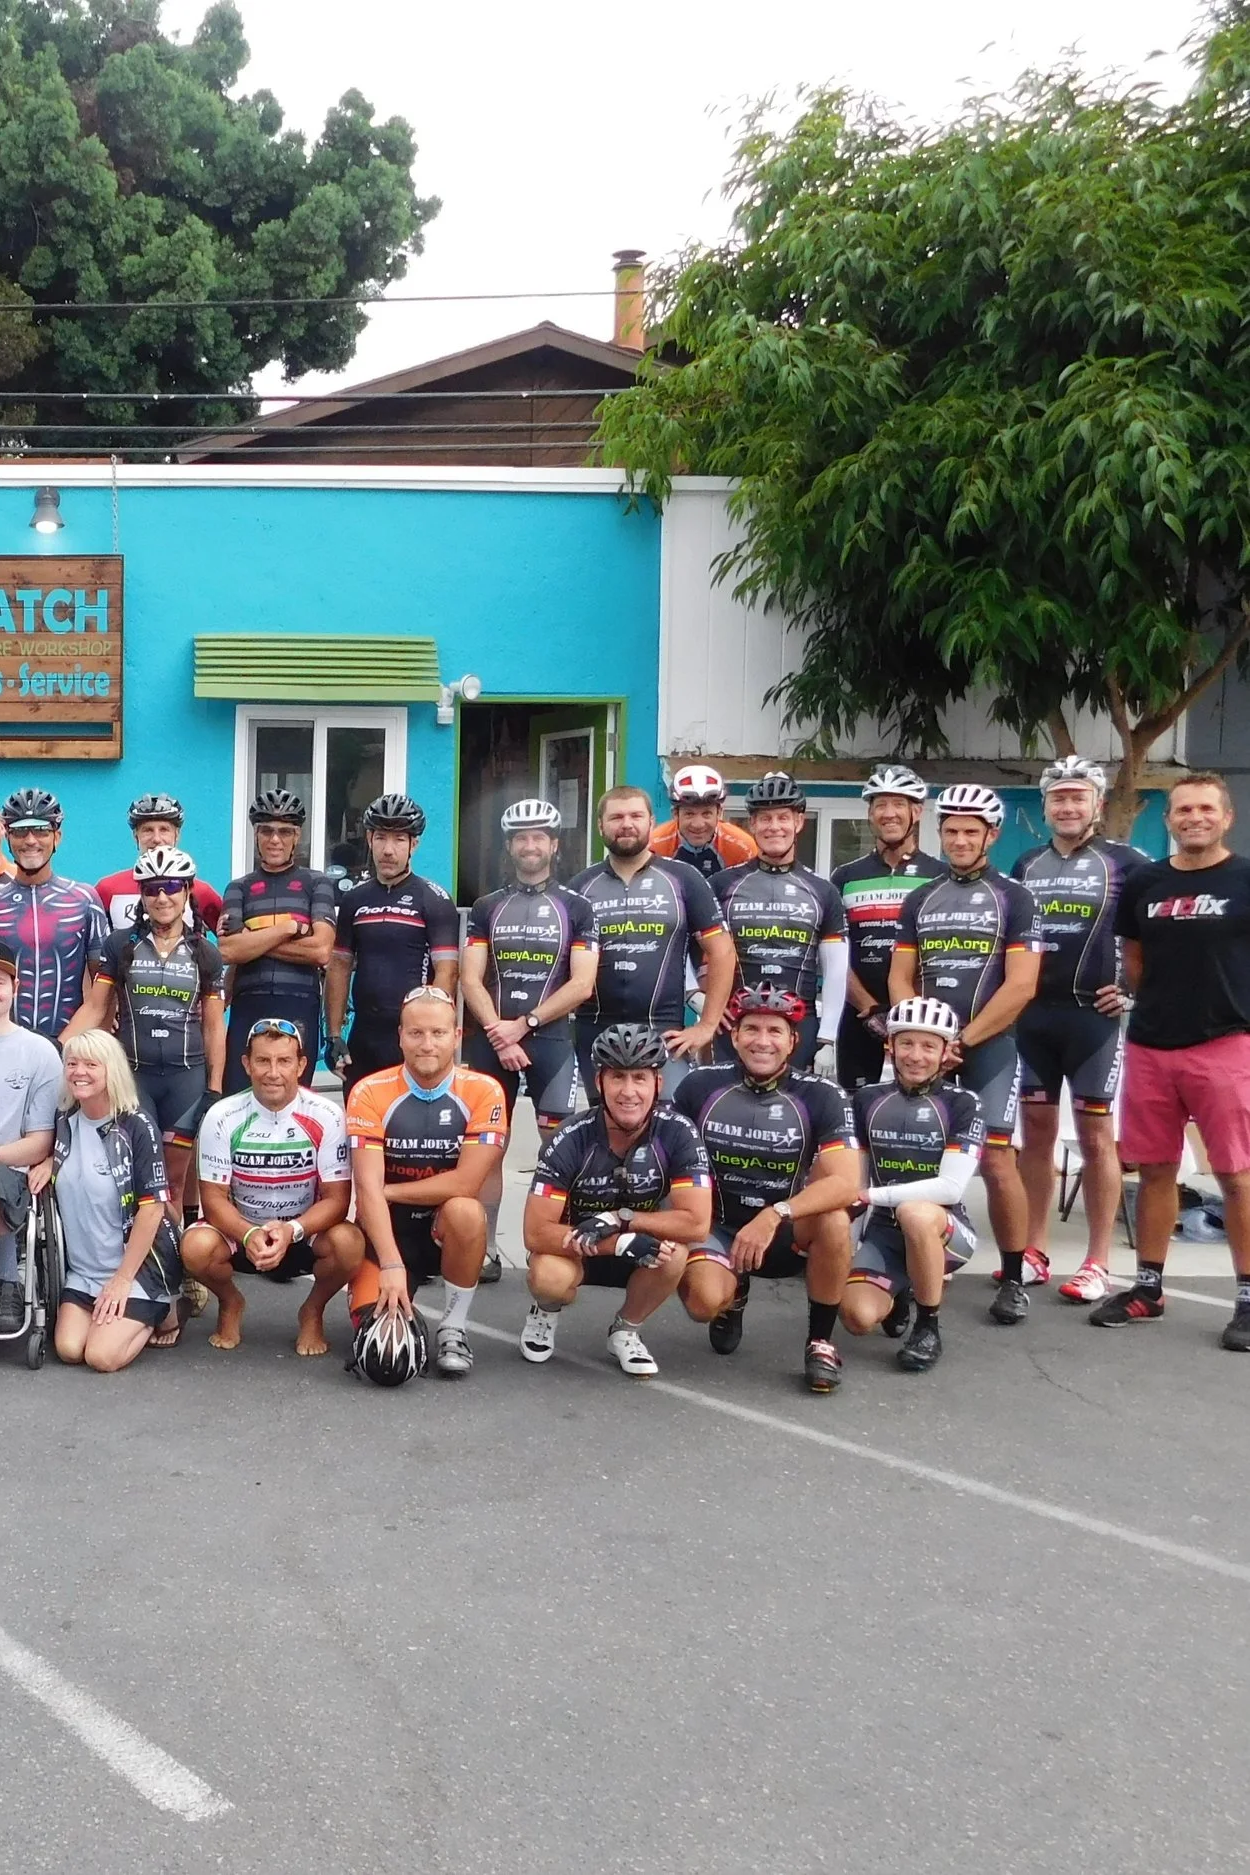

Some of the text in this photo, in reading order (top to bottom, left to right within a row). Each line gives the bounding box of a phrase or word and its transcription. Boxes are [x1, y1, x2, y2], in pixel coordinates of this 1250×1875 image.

[18, 640, 112, 656] WORKSHOP
[18, 661, 110, 697] Service
[620, 896, 649, 907] JOEY
[855, 893, 883, 902] TEAM
[354, 905, 419, 917] Pioneer
[733, 902, 795, 912] TEAM JOEY
[1147, 894, 1230, 919] velofix
[948, 912, 978, 922] JOEY
[495, 925, 519, 934] TEAM
[600, 921, 665, 936] oeyA.org
[737, 925, 807, 943] JoeyA.org
[921, 937, 990, 953] JoeyA.org
[132, 959, 155, 967] TEAM
[497, 950, 554, 964] JoeyA.org
[761, 964, 782, 974] HBO
[132, 984, 190, 1001] JoeyA.org
[151, 1028, 170, 1037] HBO
[707, 1120, 780, 1143] TEAM JOEY
[871, 1129, 925, 1142] TEAM JOEY
[385, 1137, 452, 1150] TEAM JOEY
[234, 1154, 296, 1166] TEAM JOEY
[711, 1151, 795, 1174] JoeyA.org
[740, 1195, 766, 1207] HBO
